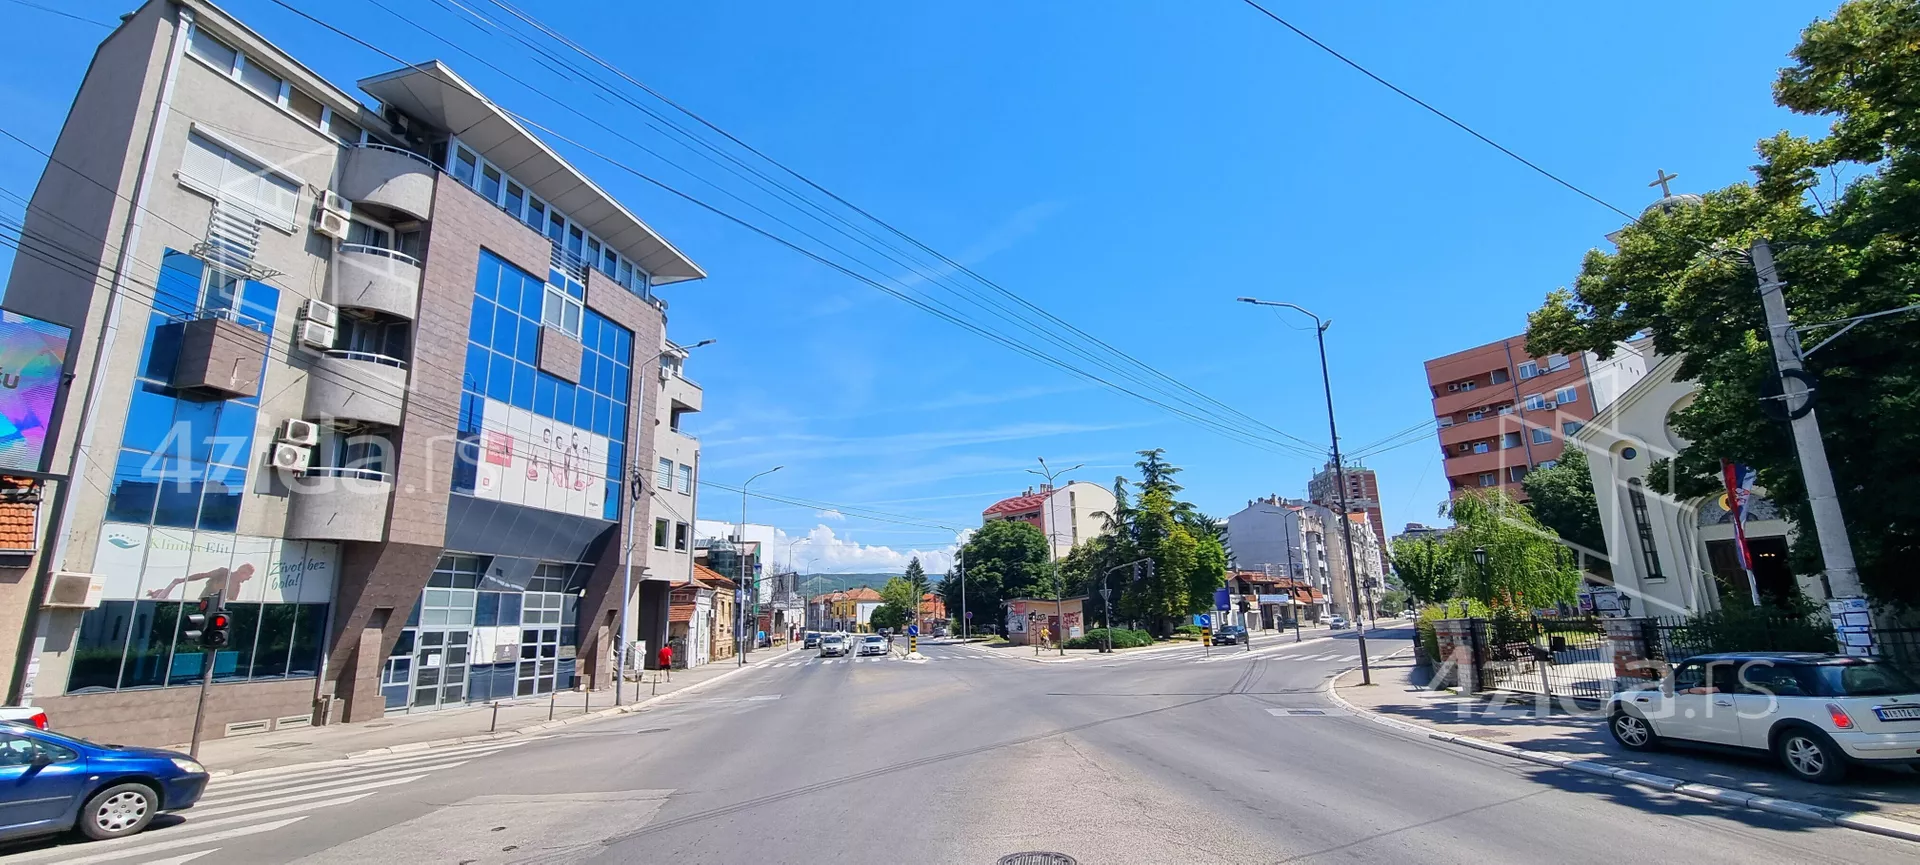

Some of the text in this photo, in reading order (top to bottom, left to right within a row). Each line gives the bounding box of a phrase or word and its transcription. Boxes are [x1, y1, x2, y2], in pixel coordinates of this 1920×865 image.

[205, 541, 231, 554] Elit
[307, 558, 326, 571] bez
[271, 573, 301, 590] bola!
